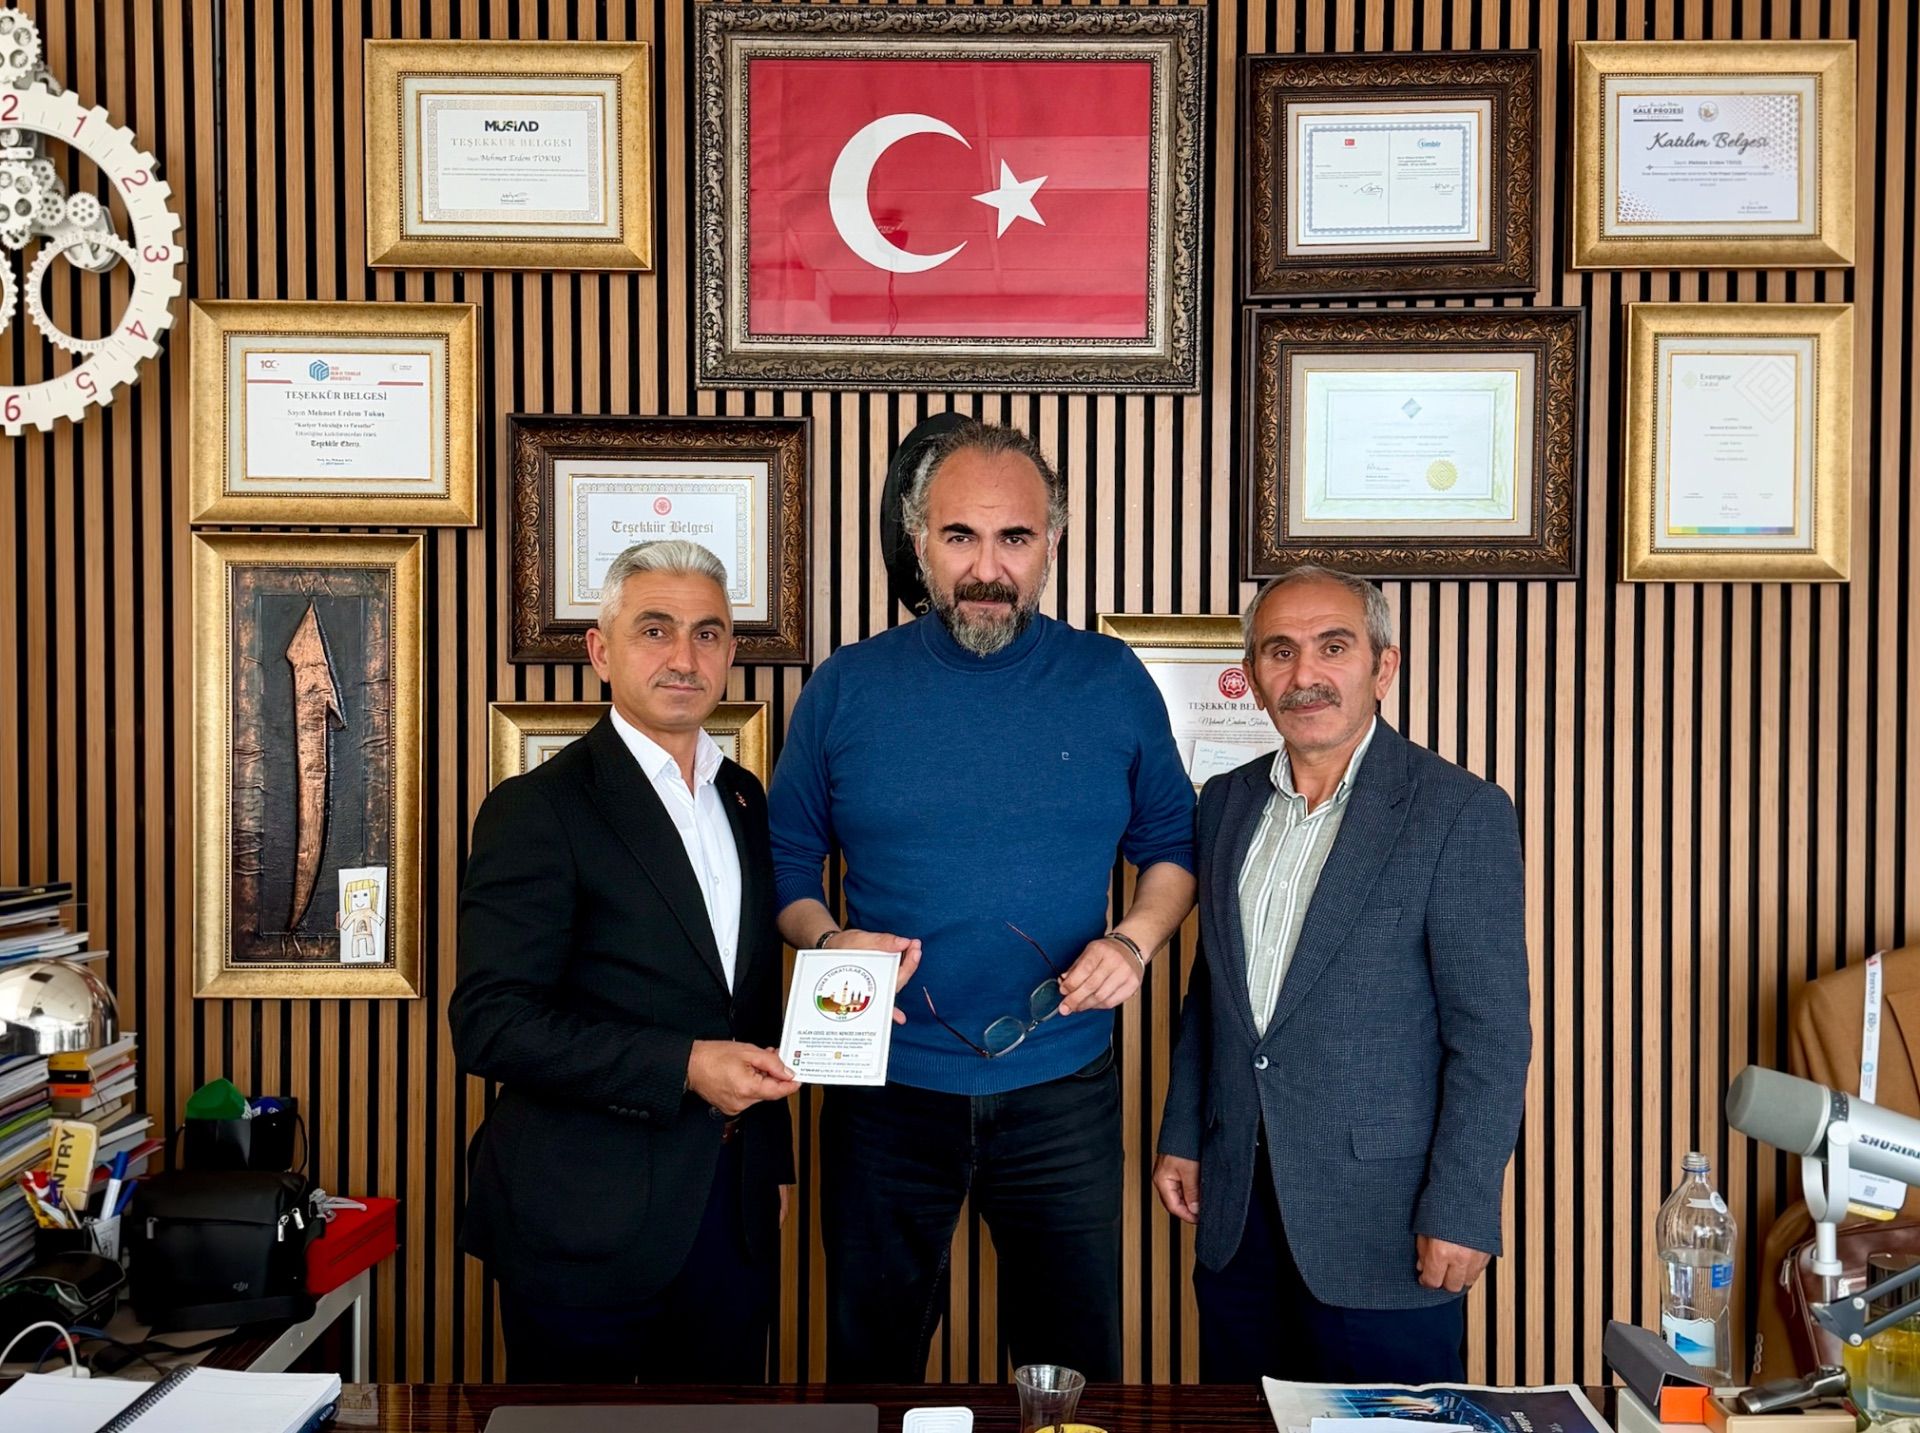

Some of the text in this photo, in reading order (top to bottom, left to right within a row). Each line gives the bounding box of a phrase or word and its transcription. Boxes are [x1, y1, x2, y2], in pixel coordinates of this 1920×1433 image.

[1, 94, 19, 121] 2
[72, 115, 87, 138] 1
[1646, 132, 1769, 155] Katılım Belgesi
[121, 169, 149, 194] 2
[143, 245, 171, 263] 3
[125, 319, 149, 341] 4
[76, 372, 97, 399] 5
[284, 390, 387, 402] TEŞEKKÜR BELGESİ
[4, 394, 21, 421] 6
[611, 520, 714, 537] Teşekkür Belgesi
[1188, 701, 1237, 711] TEŞEKKÜR
[53, 1129, 75, 1203] NTRY
